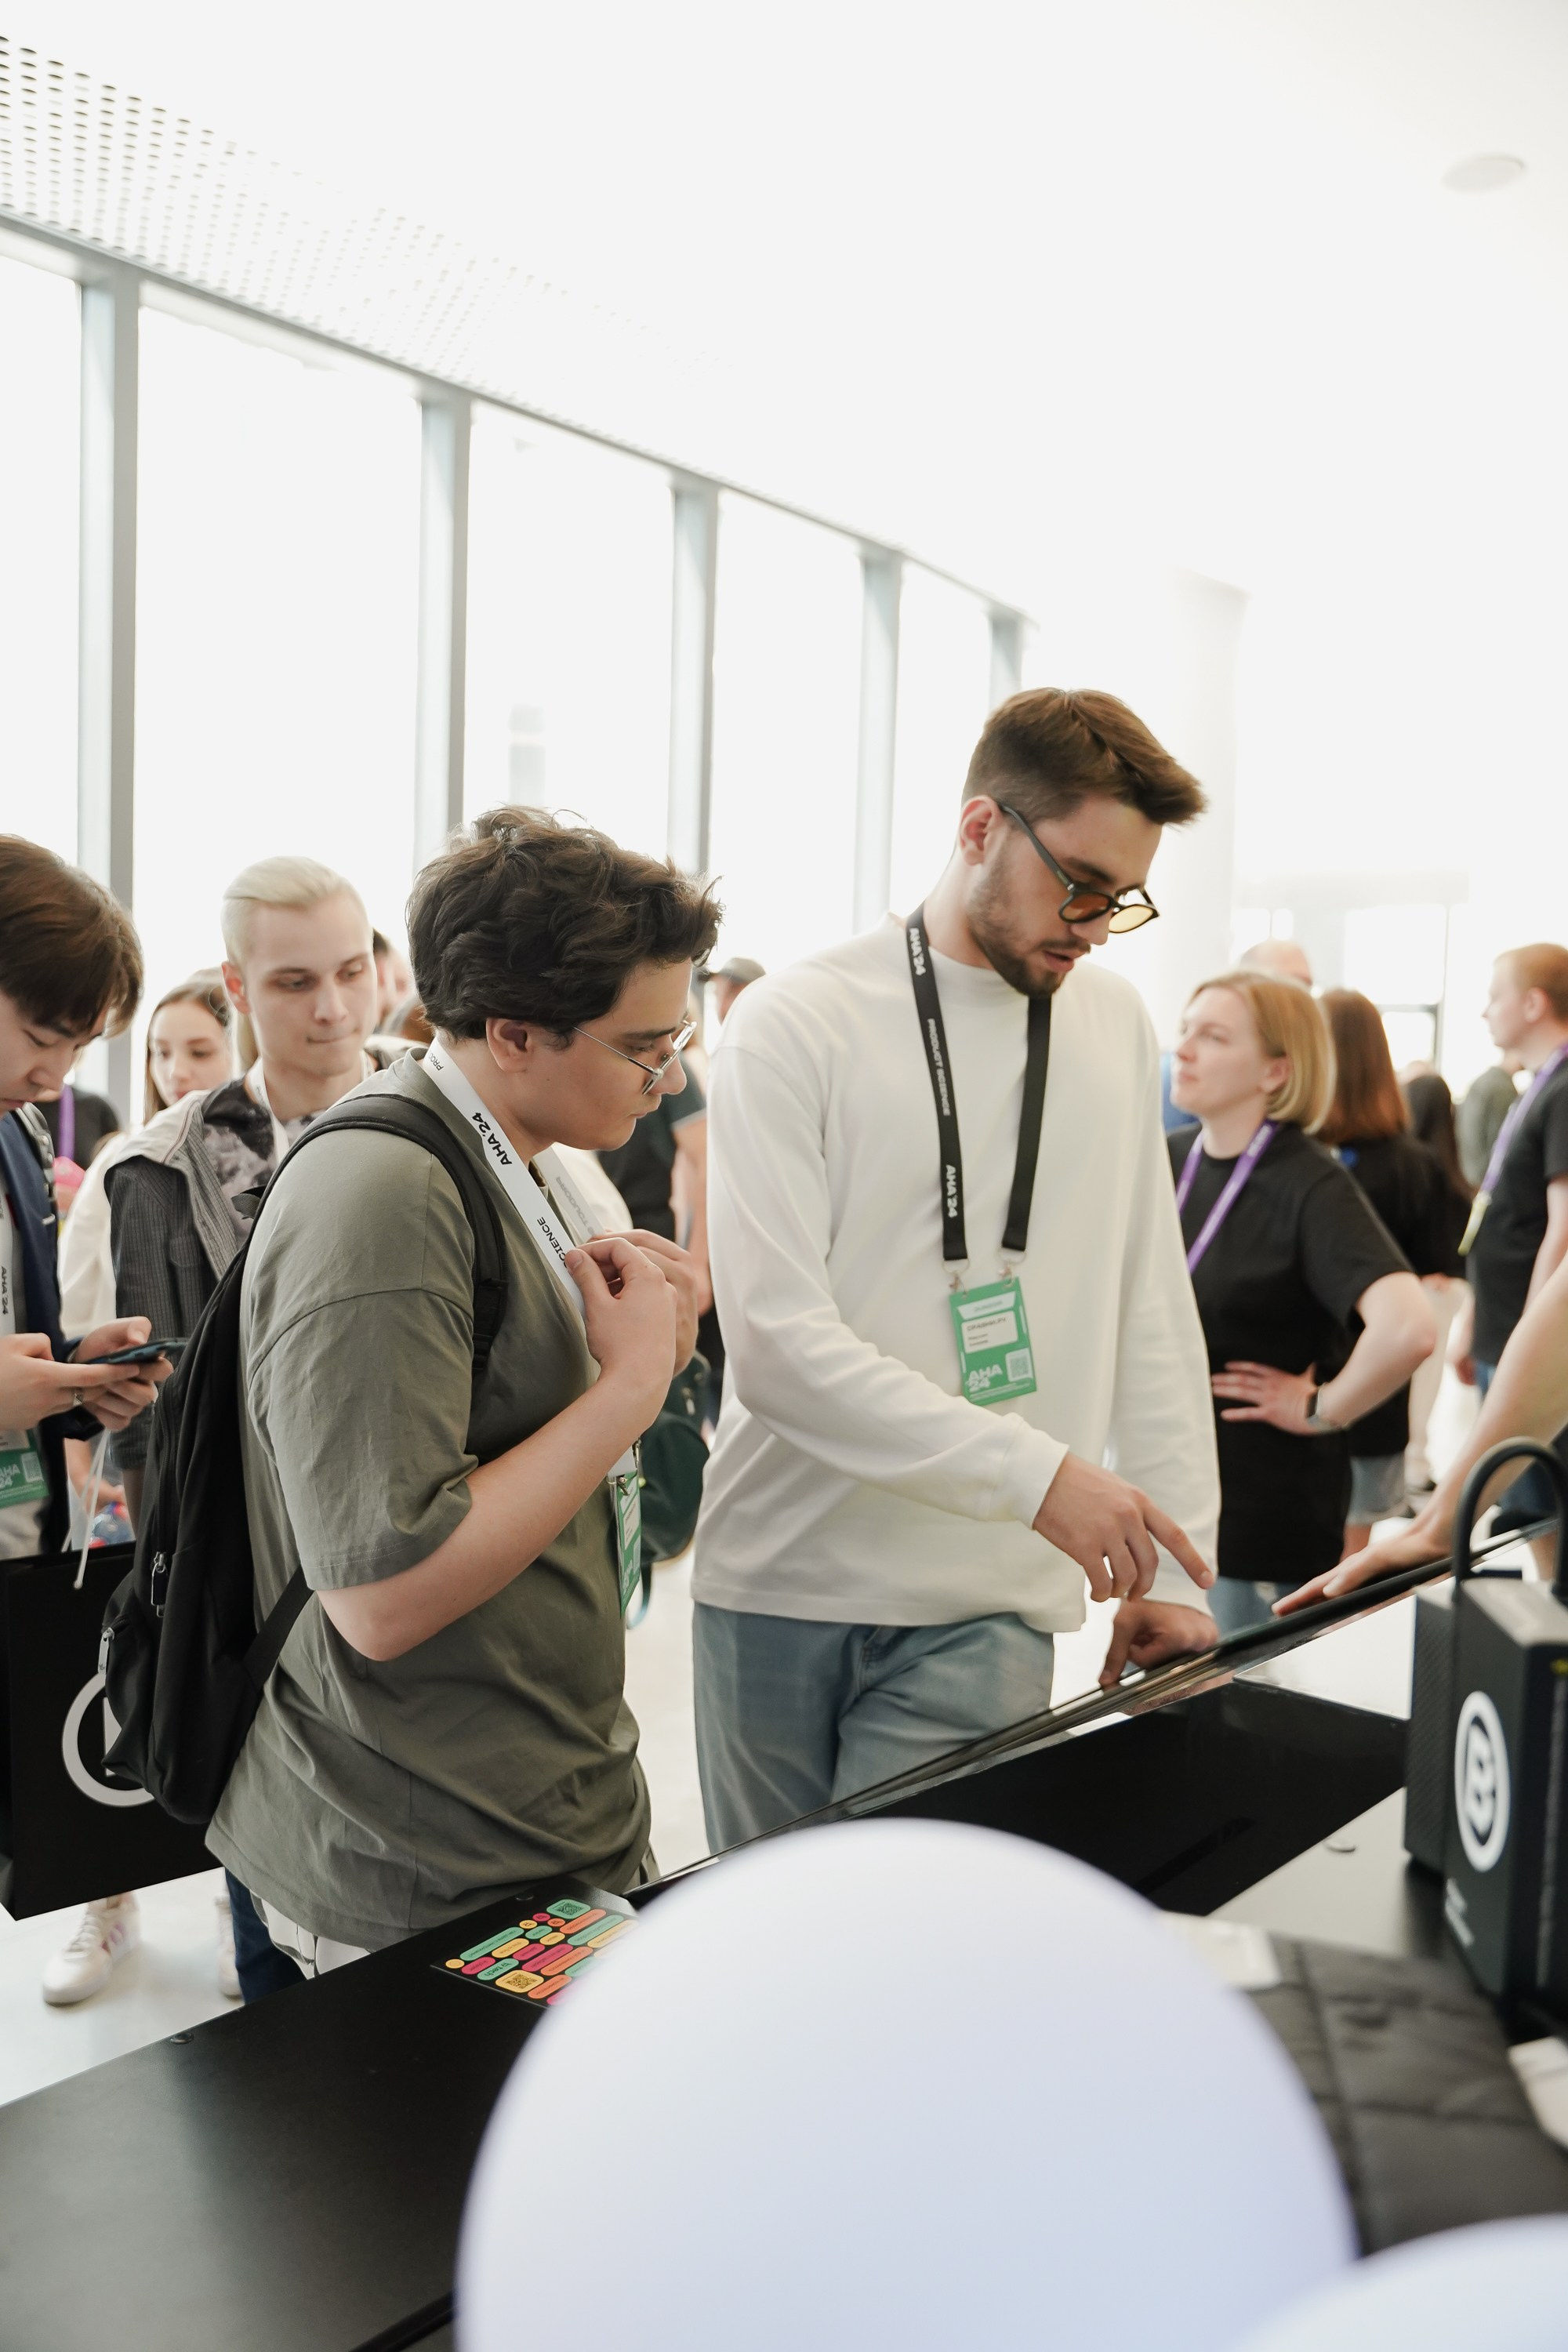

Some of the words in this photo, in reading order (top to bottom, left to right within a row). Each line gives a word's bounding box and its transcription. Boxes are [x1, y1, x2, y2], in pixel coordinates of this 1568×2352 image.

[927, 1018, 944, 1069] PRODUCT
[537, 1216, 568, 1269] CIENCE
[968, 1363, 1003, 1381] AHA
[485, 1962, 503, 1976] tech
